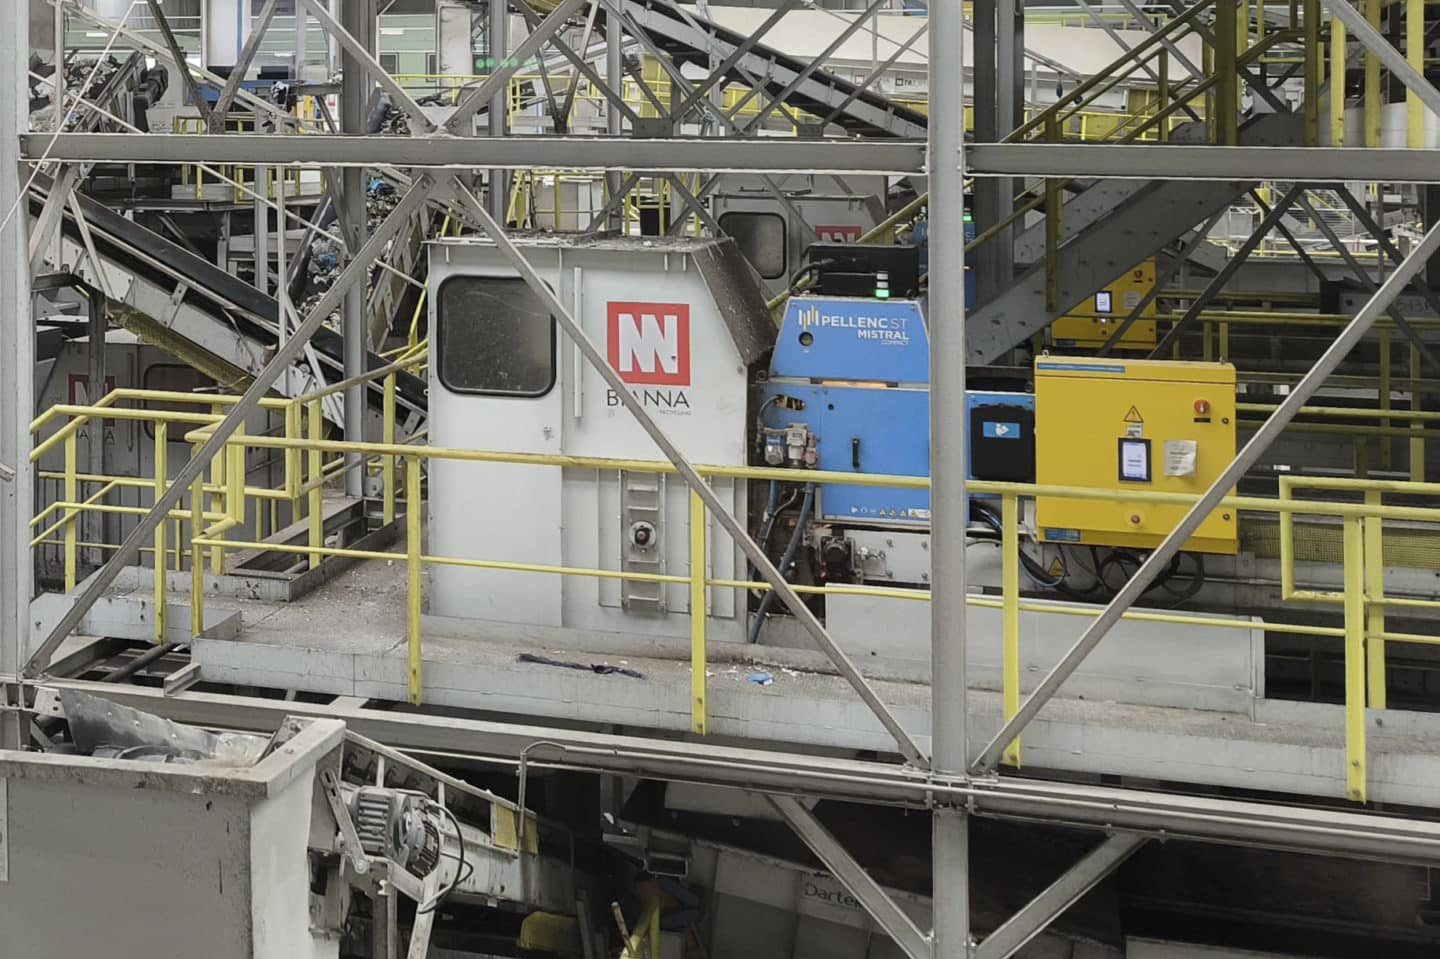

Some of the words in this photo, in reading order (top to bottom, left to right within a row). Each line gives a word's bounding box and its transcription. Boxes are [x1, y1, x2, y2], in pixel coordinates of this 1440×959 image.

[821, 315, 888, 329] PELLENC
[890, 317, 909, 329] ST
[858, 329, 909, 340] MISTRAL
